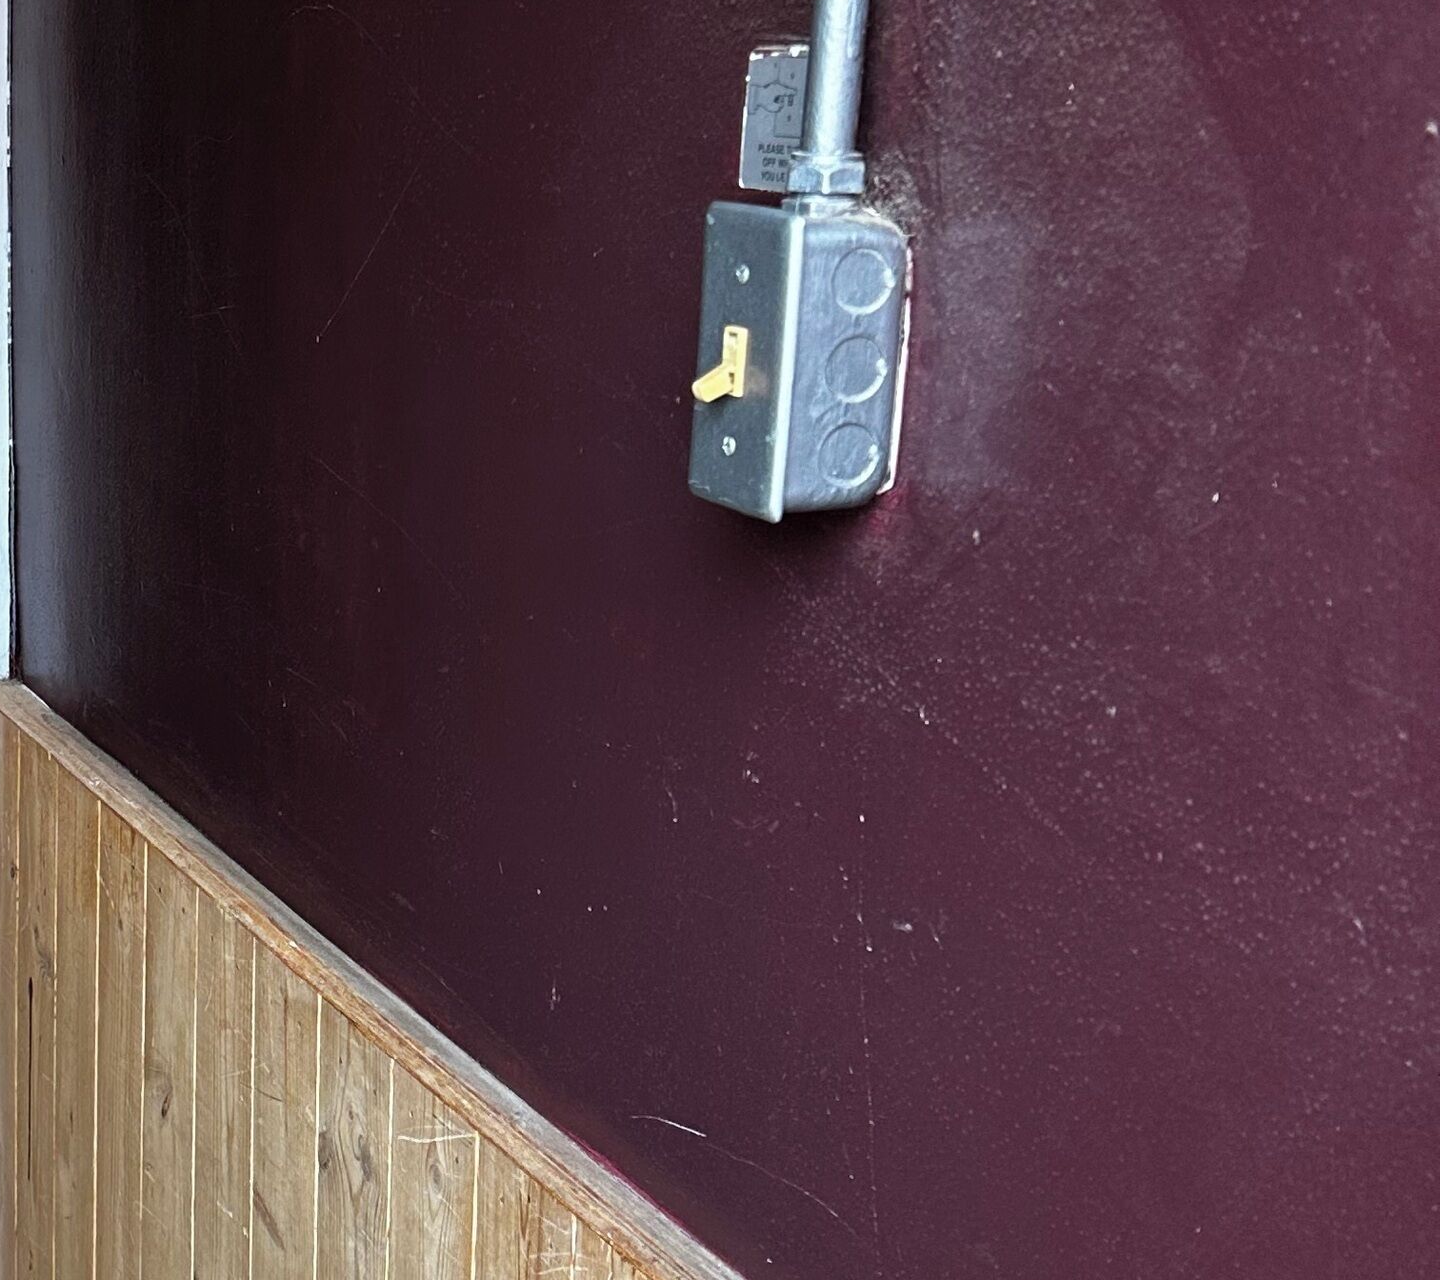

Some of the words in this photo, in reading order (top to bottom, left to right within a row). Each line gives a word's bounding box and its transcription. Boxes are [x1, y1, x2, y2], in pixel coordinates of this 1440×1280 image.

[758, 143, 785, 155] PLEASE
[762, 157, 777, 168] OFF
[761, 171, 775, 182] YOU
